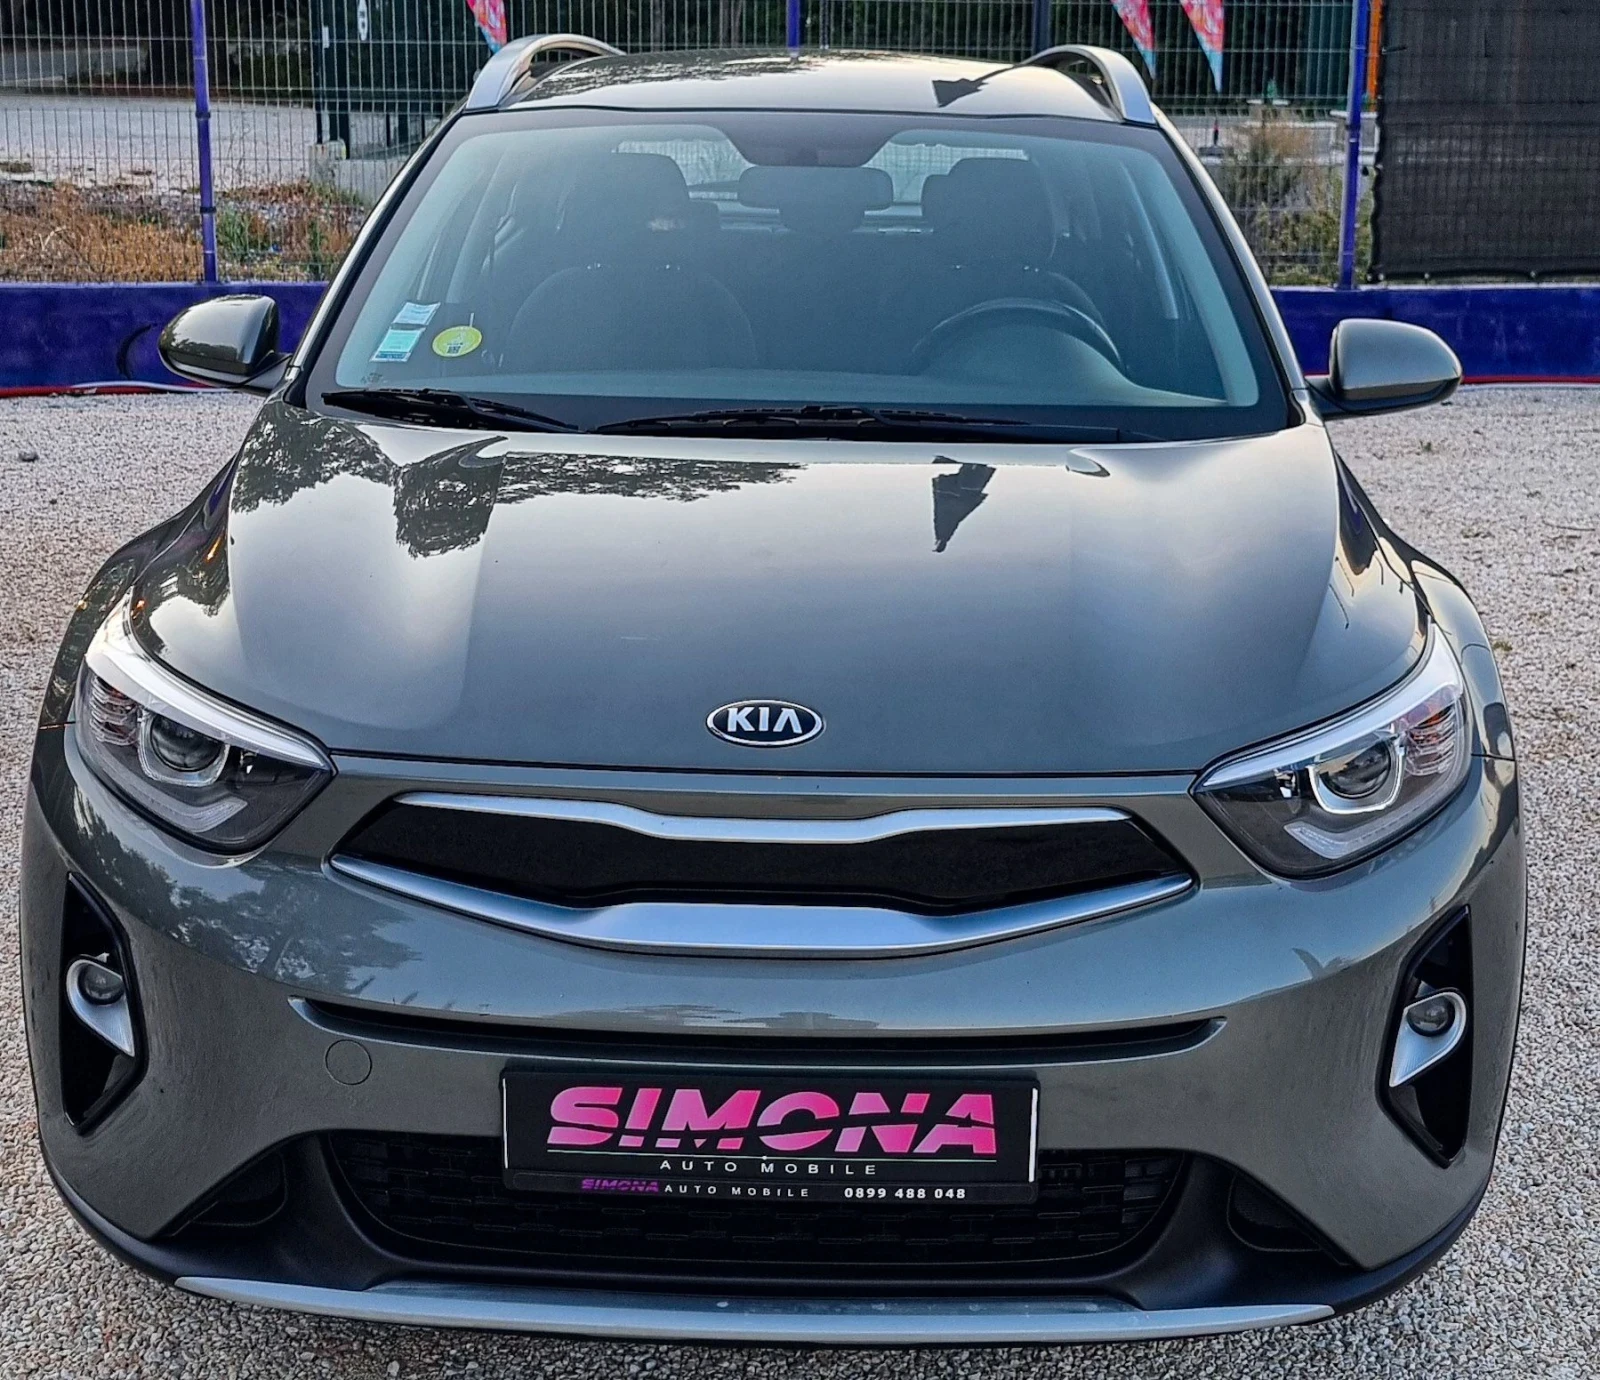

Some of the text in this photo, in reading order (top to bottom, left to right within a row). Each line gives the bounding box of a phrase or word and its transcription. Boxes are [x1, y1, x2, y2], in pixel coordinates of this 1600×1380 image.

[727, 706, 803, 734] KIA
[547, 1086, 997, 1154] SIMONA
[659, 1159, 876, 1175] AUTO MOBILE
[581, 1178, 966, 1199] SIMONA AUTO MOBILE 0899 488 048
